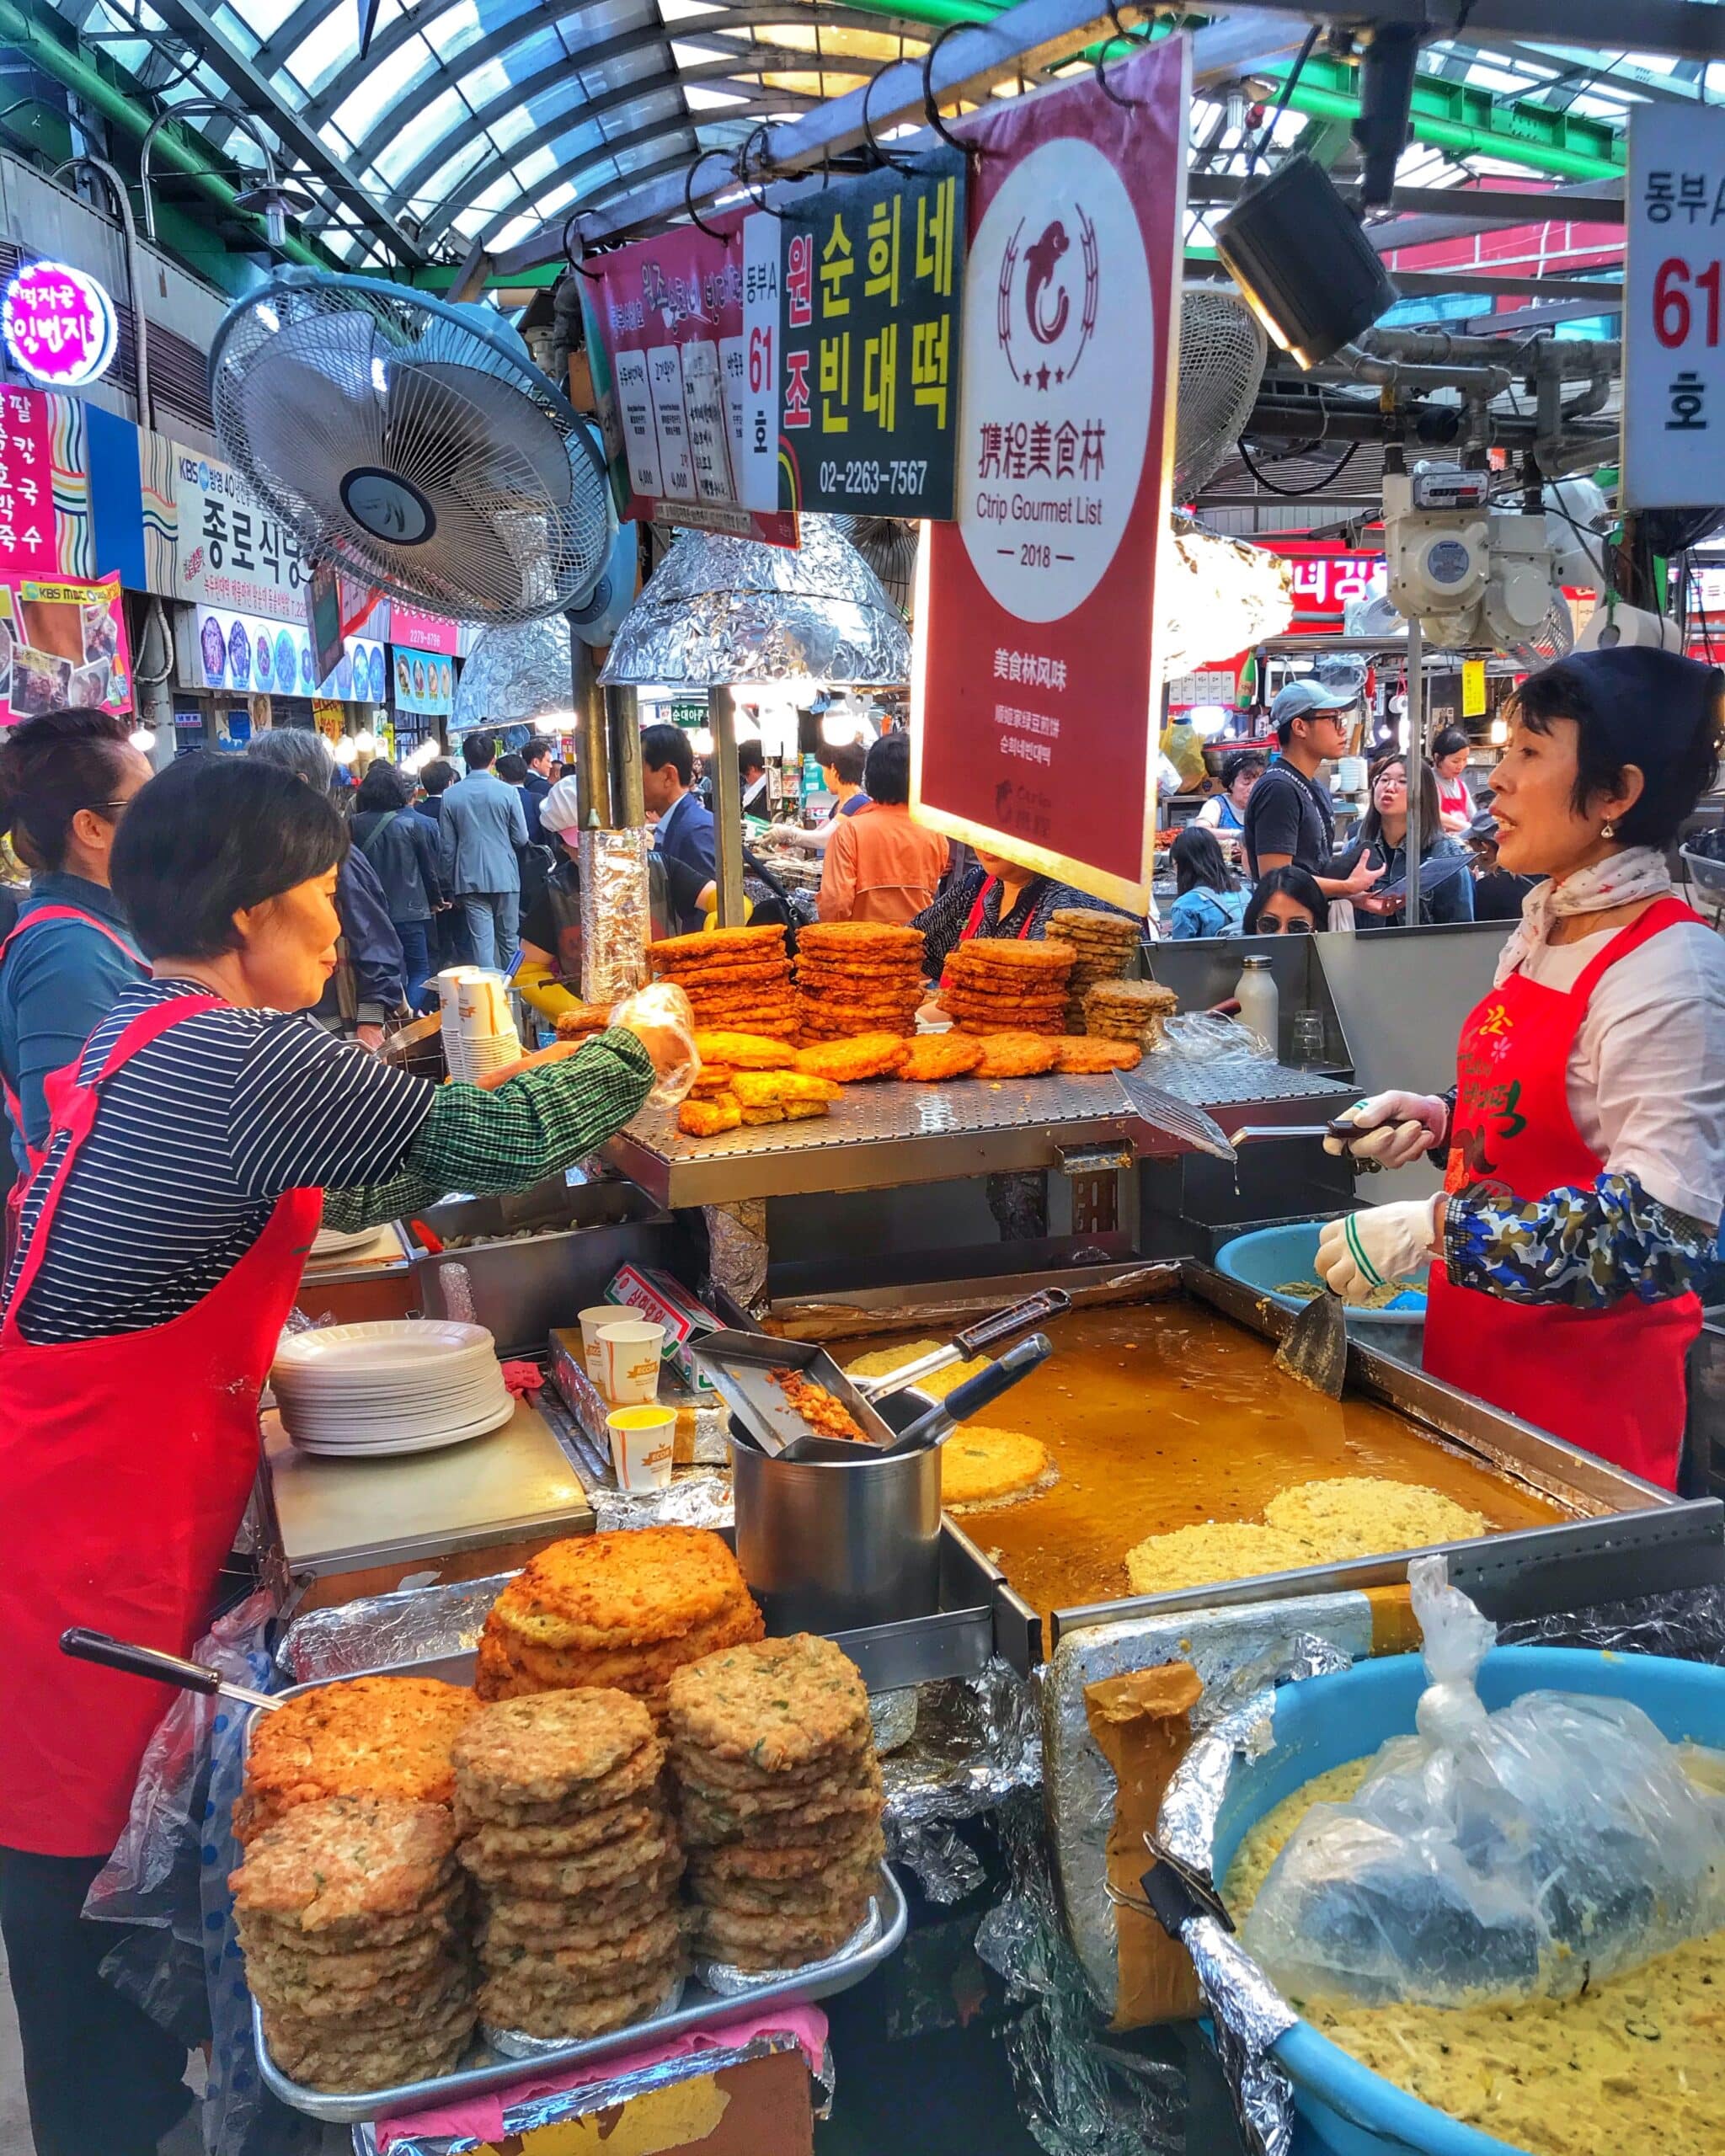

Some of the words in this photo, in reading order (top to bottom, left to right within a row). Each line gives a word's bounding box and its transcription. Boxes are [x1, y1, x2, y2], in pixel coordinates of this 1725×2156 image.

[820, 175, 956, 318] 순희네
[746, 261, 777, 304] 동부A
[1653, 257, 1722, 350] 61
[13, 312, 88, 357] 일번지
[783, 233, 813, 429] 원조
[749, 325, 772, 393] 61
[820, 313, 950, 433] 빈대떡
[1664, 371, 1707, 430] 호
[754, 409, 768, 453] 호
[979, 419, 1105, 481] 携程美食林
[179, 456, 199, 484] KBS
[820, 461, 927, 495] 02-2263-7567
[976, 493, 1007, 525] Ctrip
[1012, 494, 1072, 524] Gourmet
[1076, 496, 1103, 526] List
[1021, 543, 1050, 568] 2018
[39, 587, 61, 600] KBS
[993, 648, 1067, 691] 美食林风味
